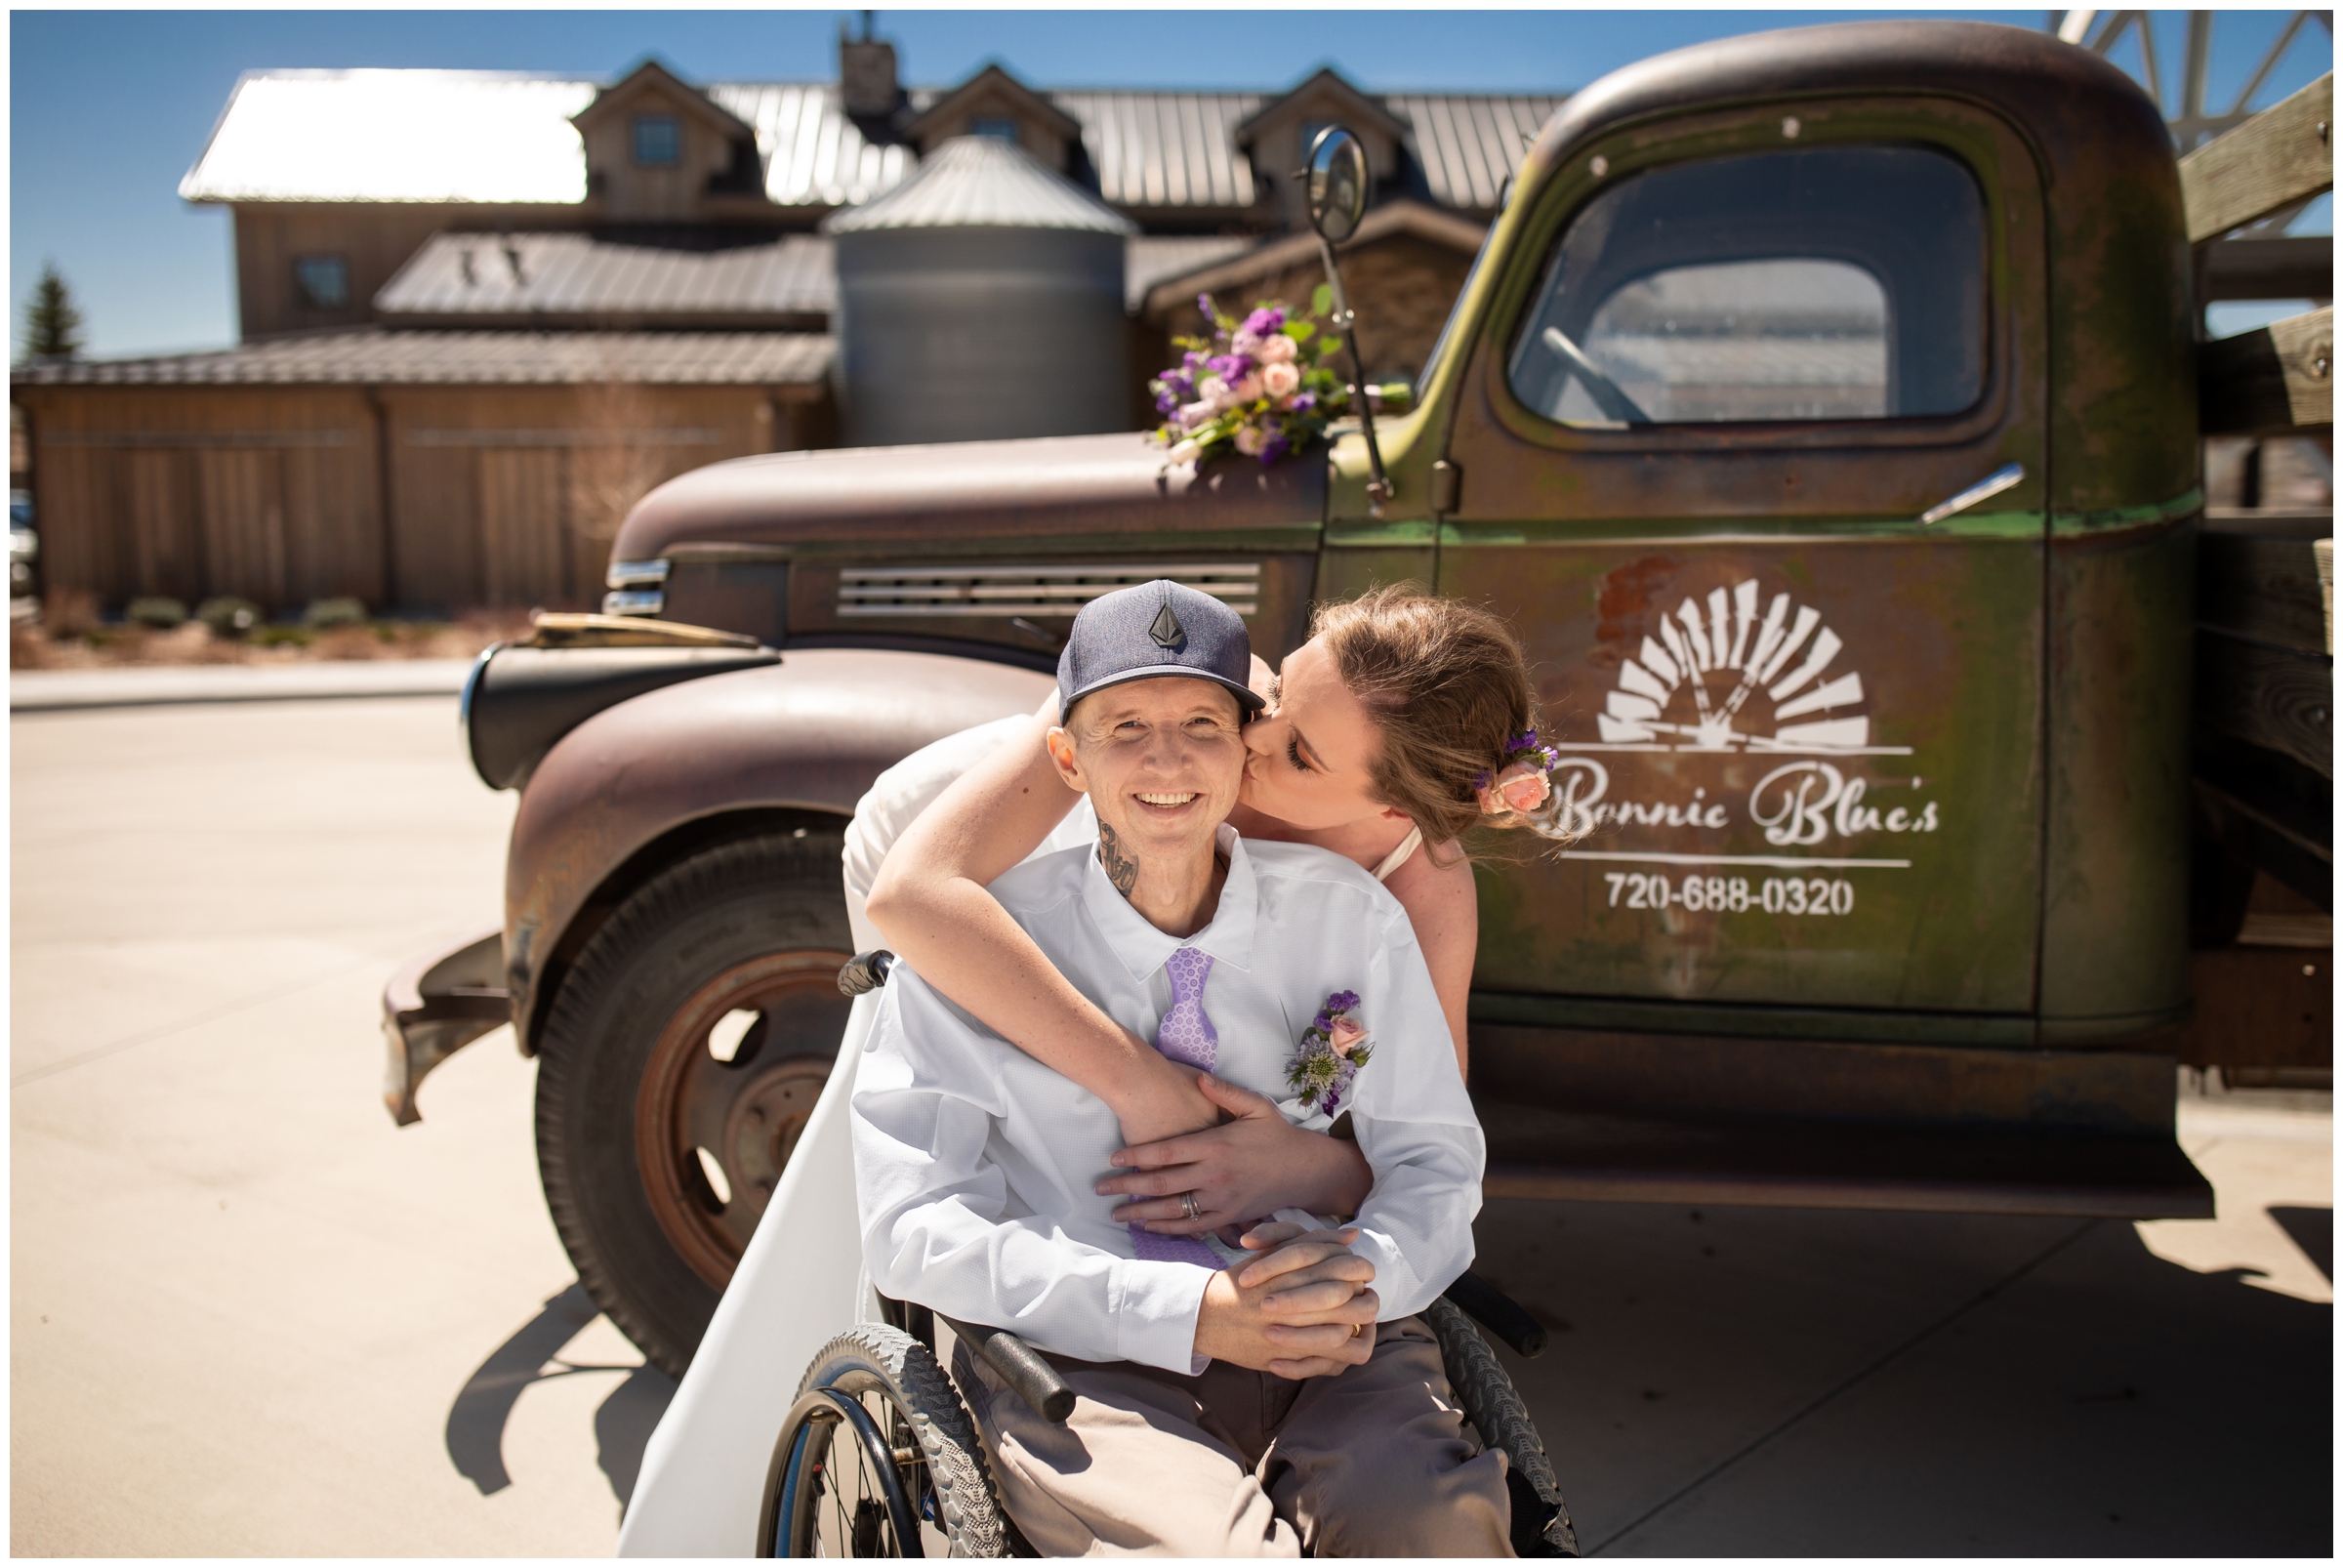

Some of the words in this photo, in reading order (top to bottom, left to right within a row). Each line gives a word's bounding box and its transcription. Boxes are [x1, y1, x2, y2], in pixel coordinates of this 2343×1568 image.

[1533, 757, 1729, 840] Bonnie
[1748, 760, 1939, 846] Blue's
[1604, 872, 1854, 916] 720-688-0320
